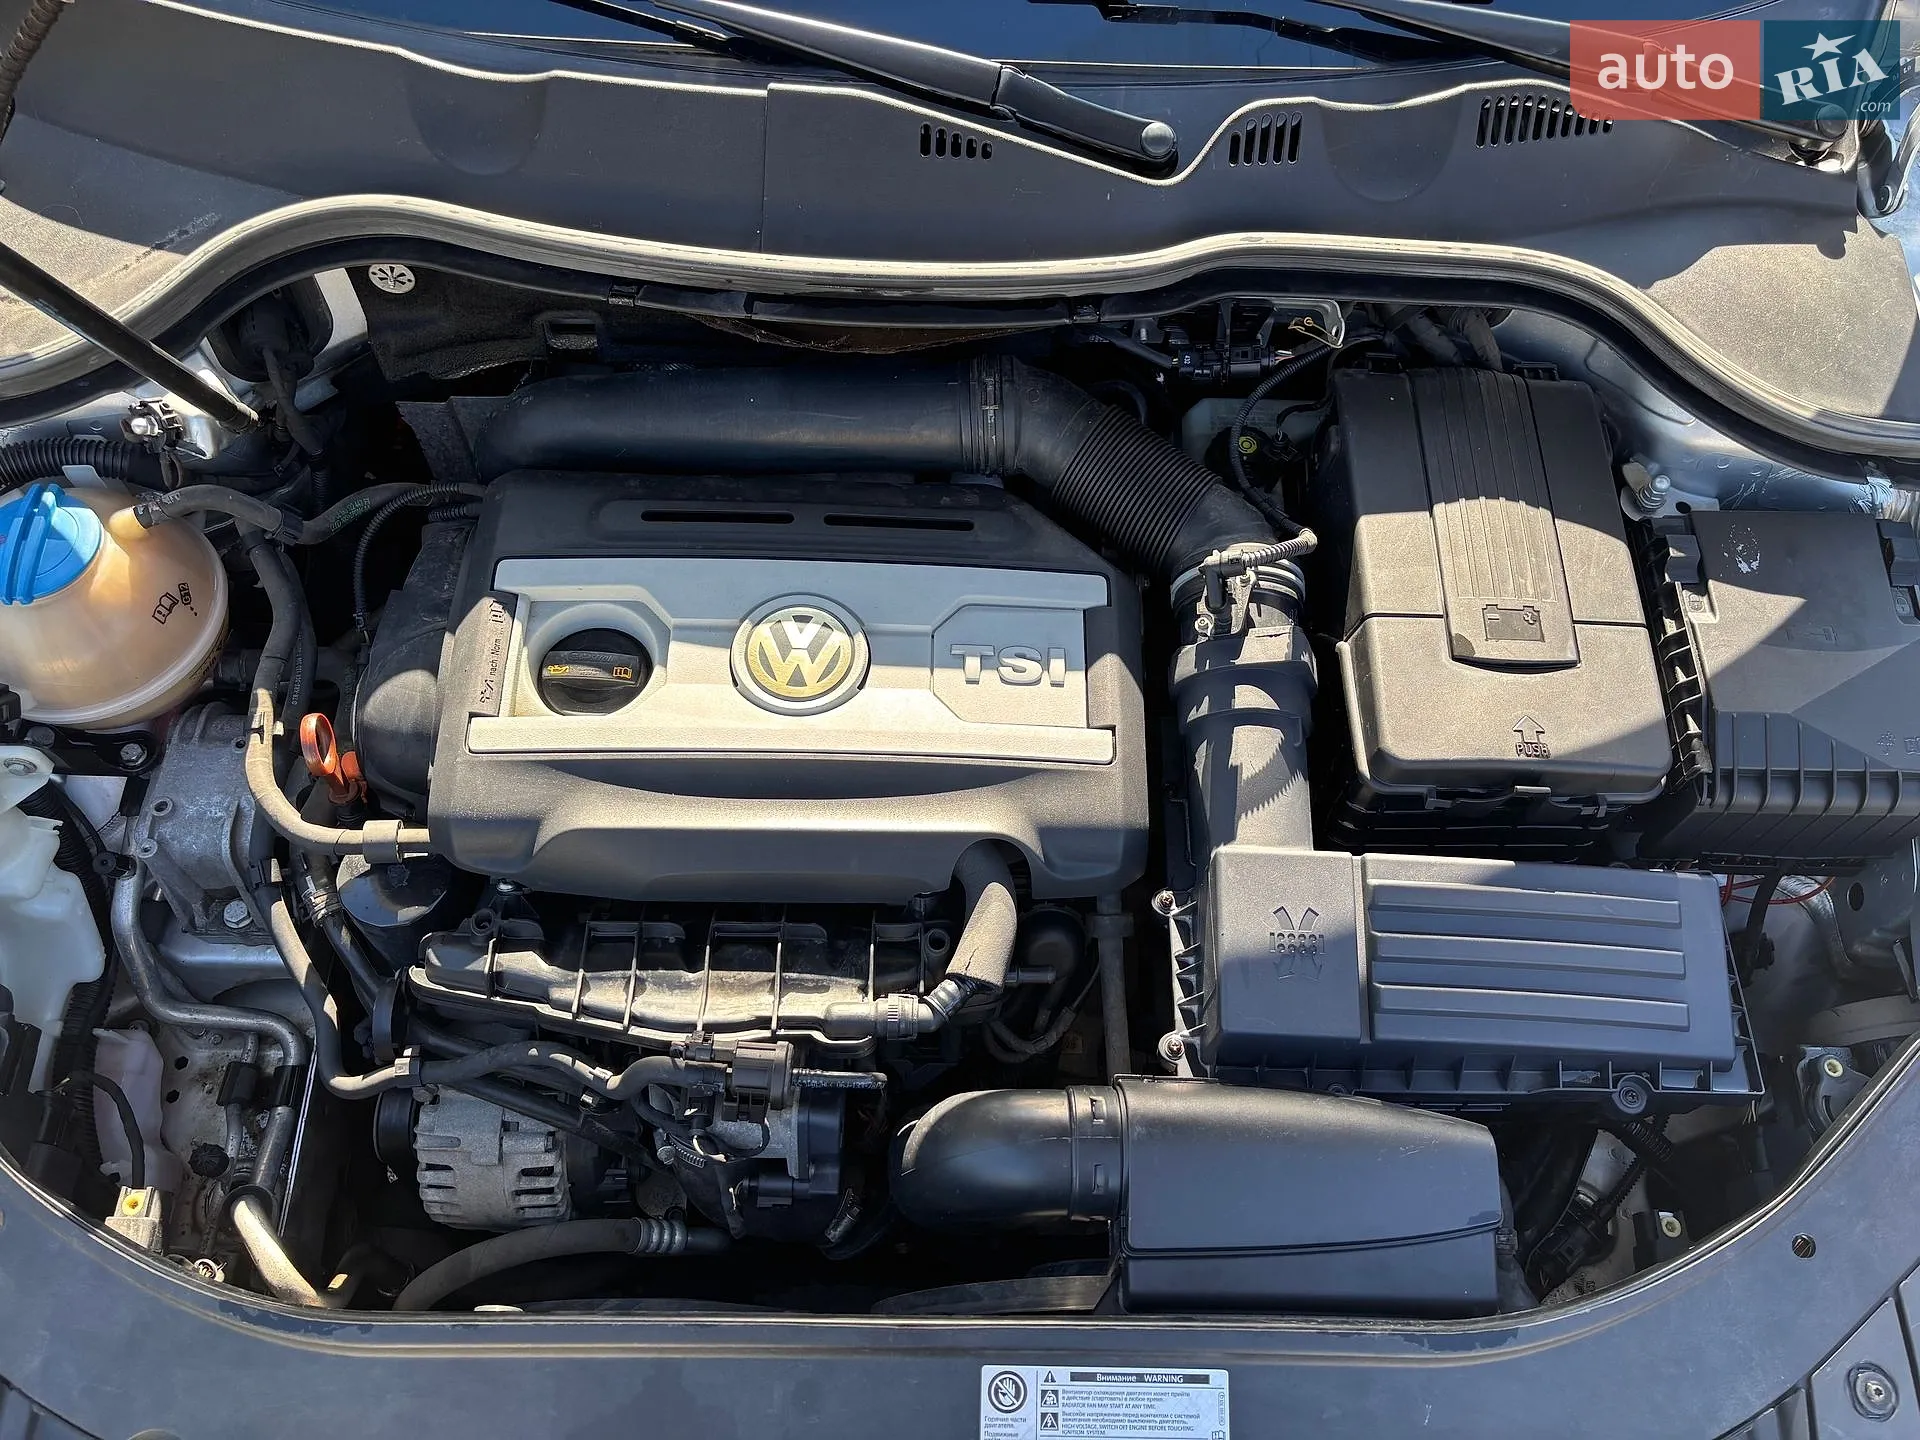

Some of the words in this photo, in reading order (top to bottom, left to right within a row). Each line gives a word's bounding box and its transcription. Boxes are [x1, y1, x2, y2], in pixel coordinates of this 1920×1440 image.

[491, 638, 501, 657] Norm
[746, 606, 853, 699] VW
[491, 659, 500, 676] nach
[950, 643, 1067, 688] TSI
[1515, 742, 1550, 759] PUSH
[1096, 1373, 1137, 1382] Внимание
[1143, 1374, 1184, 1383] WARNING
